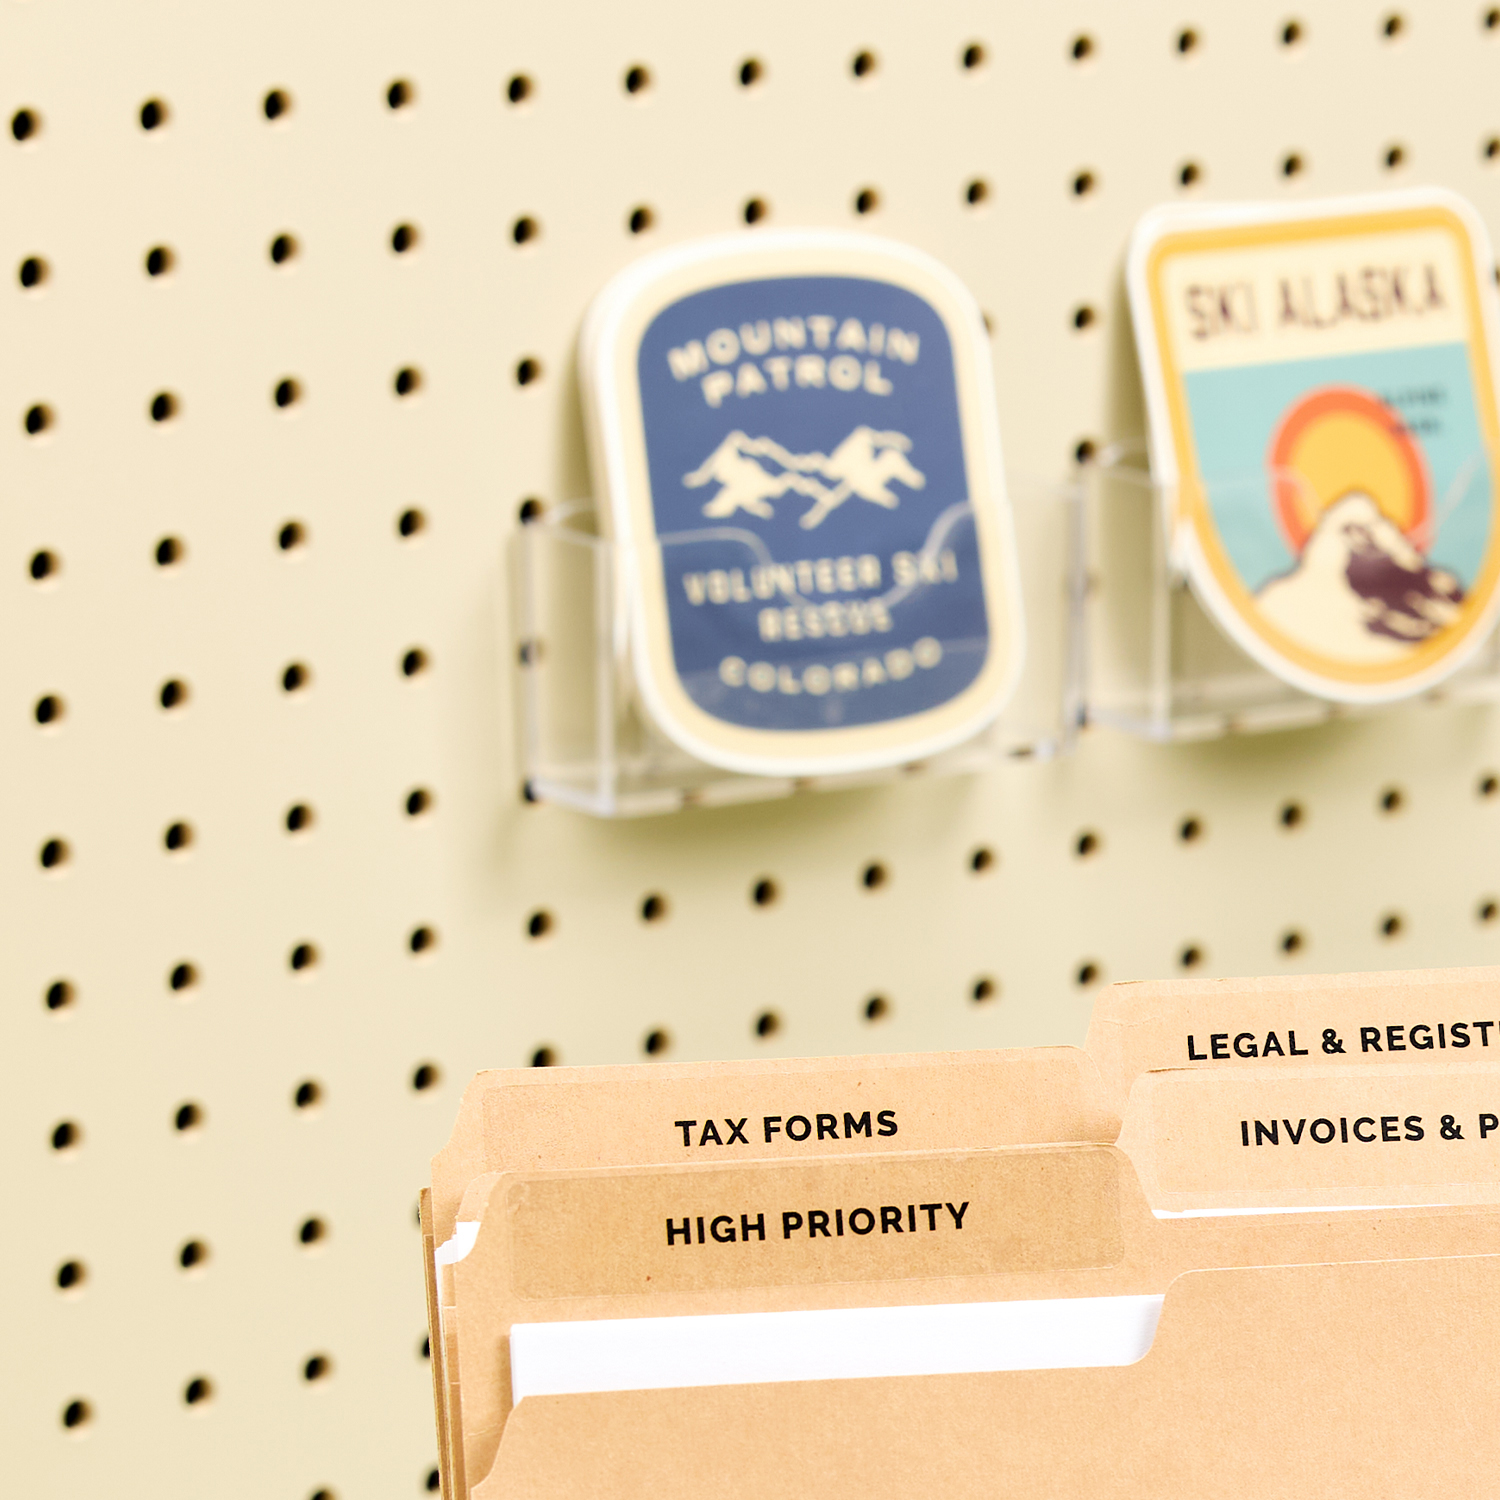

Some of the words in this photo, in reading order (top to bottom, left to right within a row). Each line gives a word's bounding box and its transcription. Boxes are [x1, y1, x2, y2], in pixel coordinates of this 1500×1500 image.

[1186, 283, 1256, 341] SKI
[1278, 262, 1449, 330] ALASKA
[667, 315, 920, 382] MOUNTAIN
[702, 354, 893, 408] PATROL
[683, 554, 882, 606] VOLUNTEER
[718, 636, 943, 697] COLORADO
[1187, 1030, 1309, 1061] LEGAL
[1321, 1028, 1347, 1055] &
[674, 1117, 750, 1147] TAX
[763, 1109, 899, 1143] FORMS
[1240, 1115, 1425, 1147] INVOICES
[1439, 1114, 1465, 1141] &
[665, 1213, 767, 1246] HIGH
[781, 1201, 970, 1240] PRIORITY
